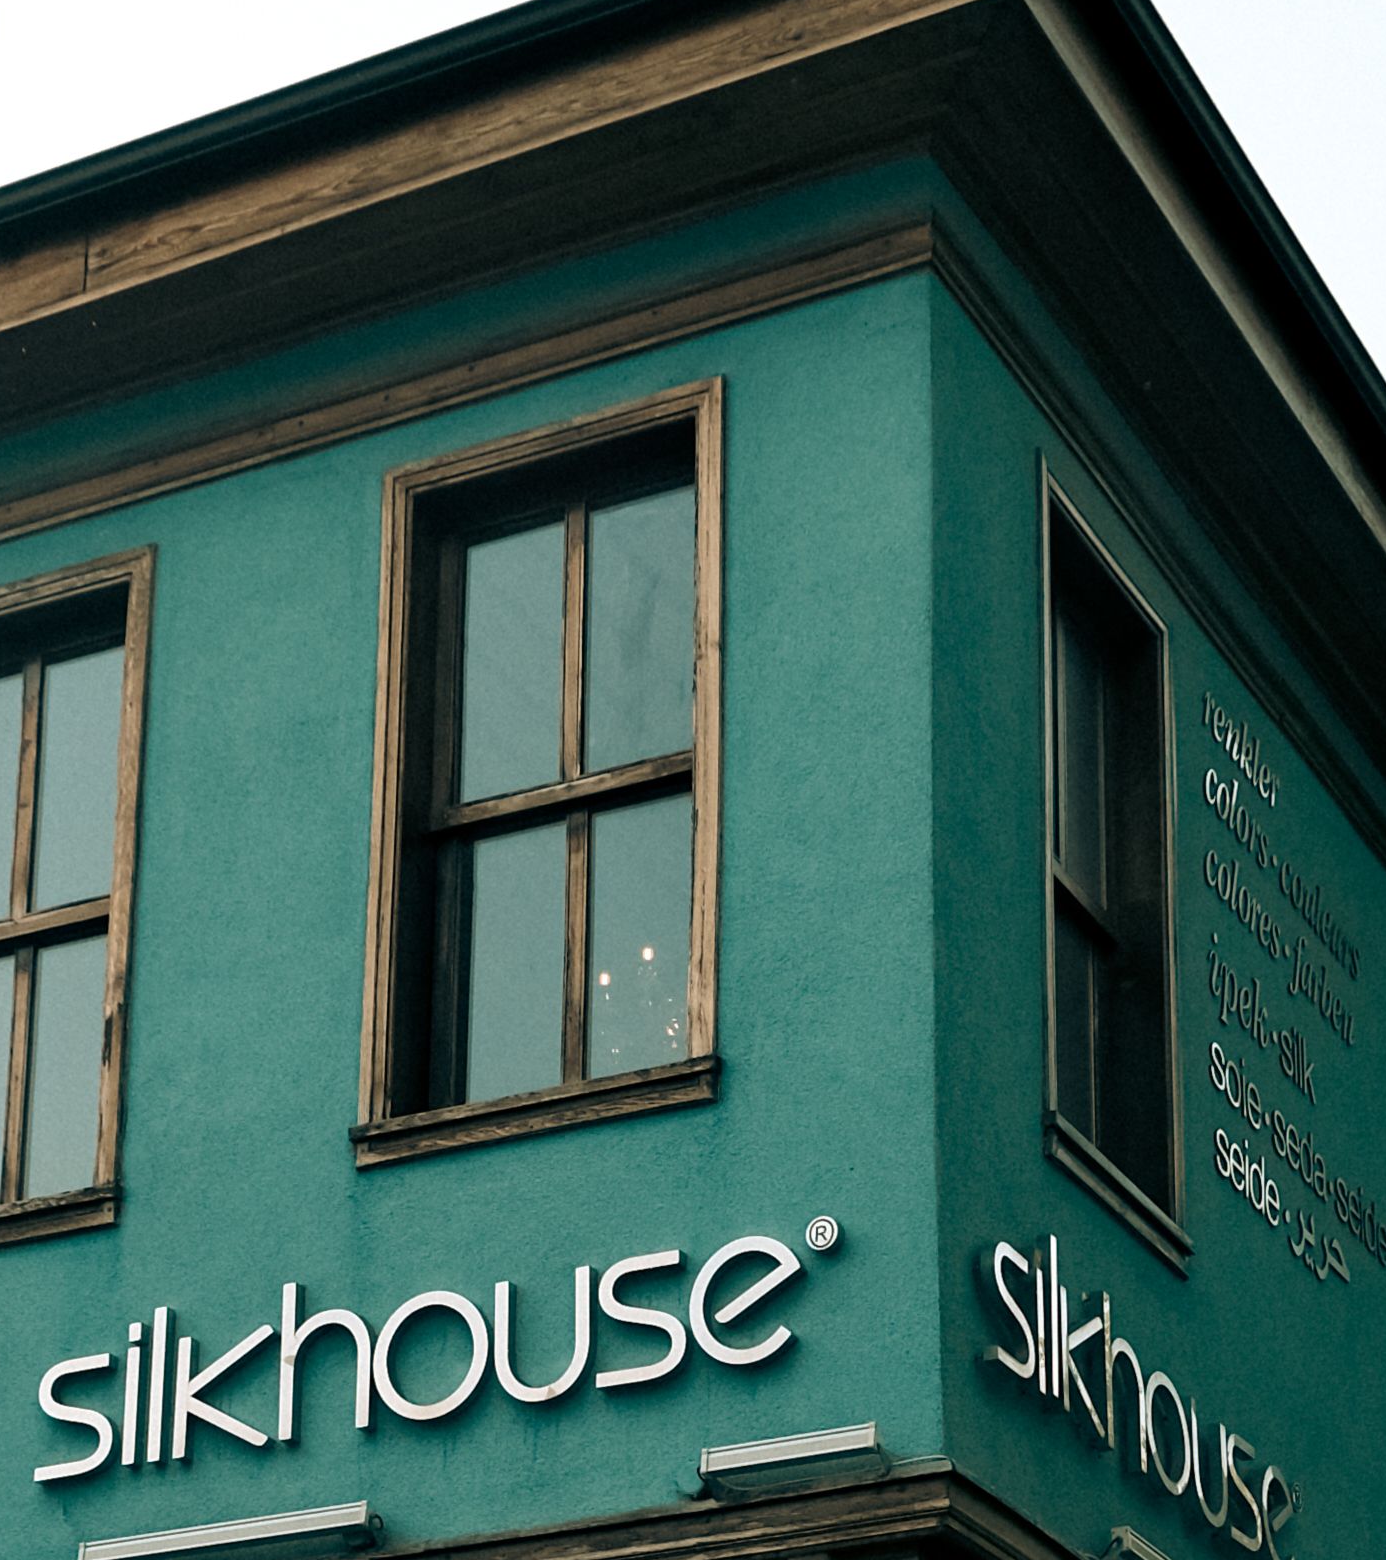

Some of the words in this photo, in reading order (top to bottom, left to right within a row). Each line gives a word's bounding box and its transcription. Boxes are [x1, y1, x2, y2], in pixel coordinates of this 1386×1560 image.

[1202, 690, 1280, 808] renkler
[1204, 766, 1268, 870] colors
[1280, 860, 1362, 980] couleurs
[1204, 847, 1280, 959] colores
[1287, 937, 1355, 1046] farben
[1207, 933, 1272, 1048] ipek
[1280, 1026, 1318, 1105] silk
[1210, 1042, 1262, 1132] soie
[1273, 1107, 1328, 1203] seda
[1213, 1127, 1280, 1228] seide
